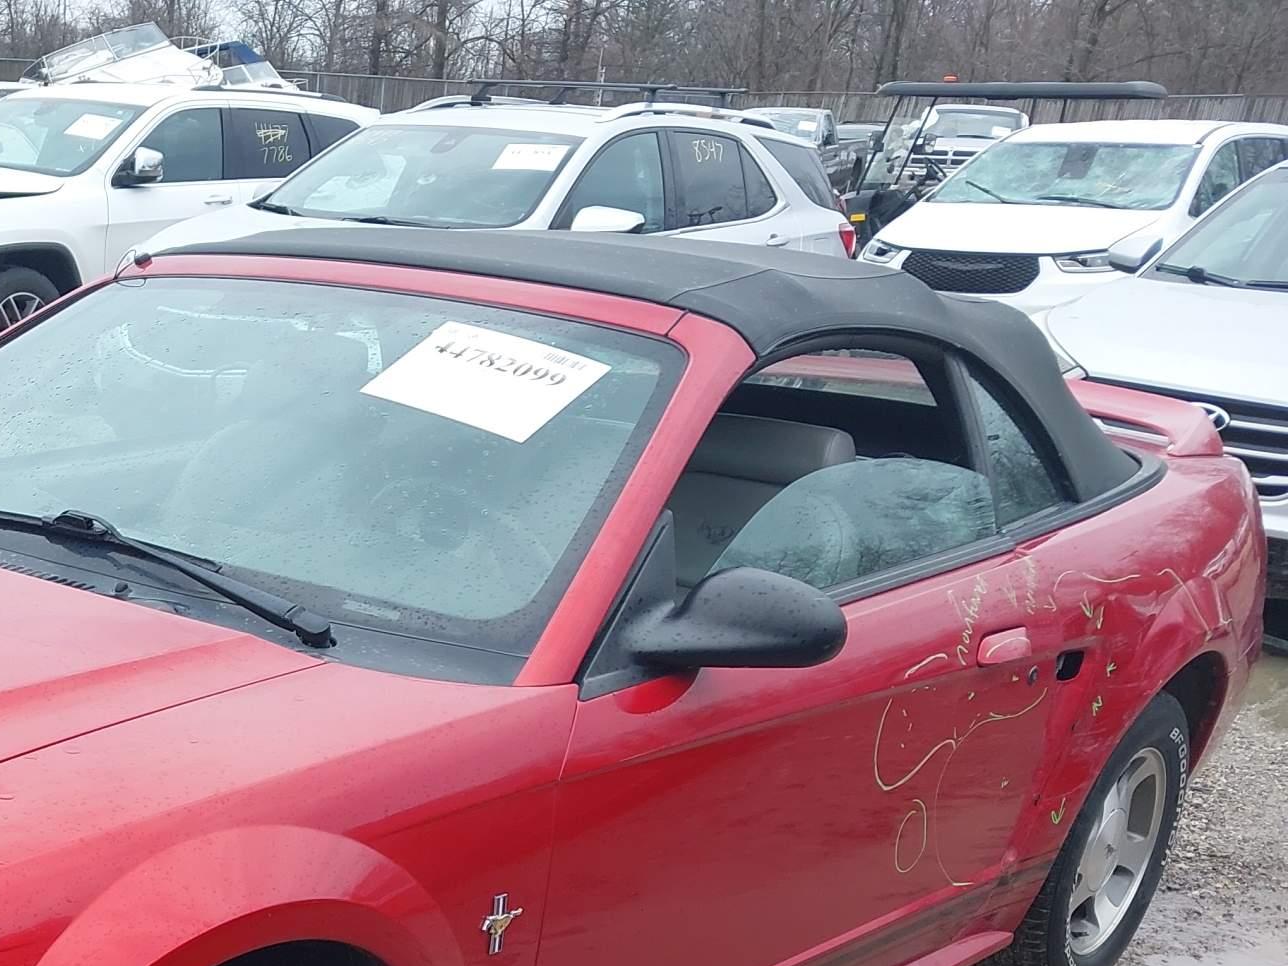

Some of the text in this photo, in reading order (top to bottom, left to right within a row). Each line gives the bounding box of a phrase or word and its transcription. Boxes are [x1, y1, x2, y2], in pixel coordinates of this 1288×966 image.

[260, 145, 293, 164] 7786
[692, 139, 723, 163] 8547
[434, 341, 567, 387] 44782099
